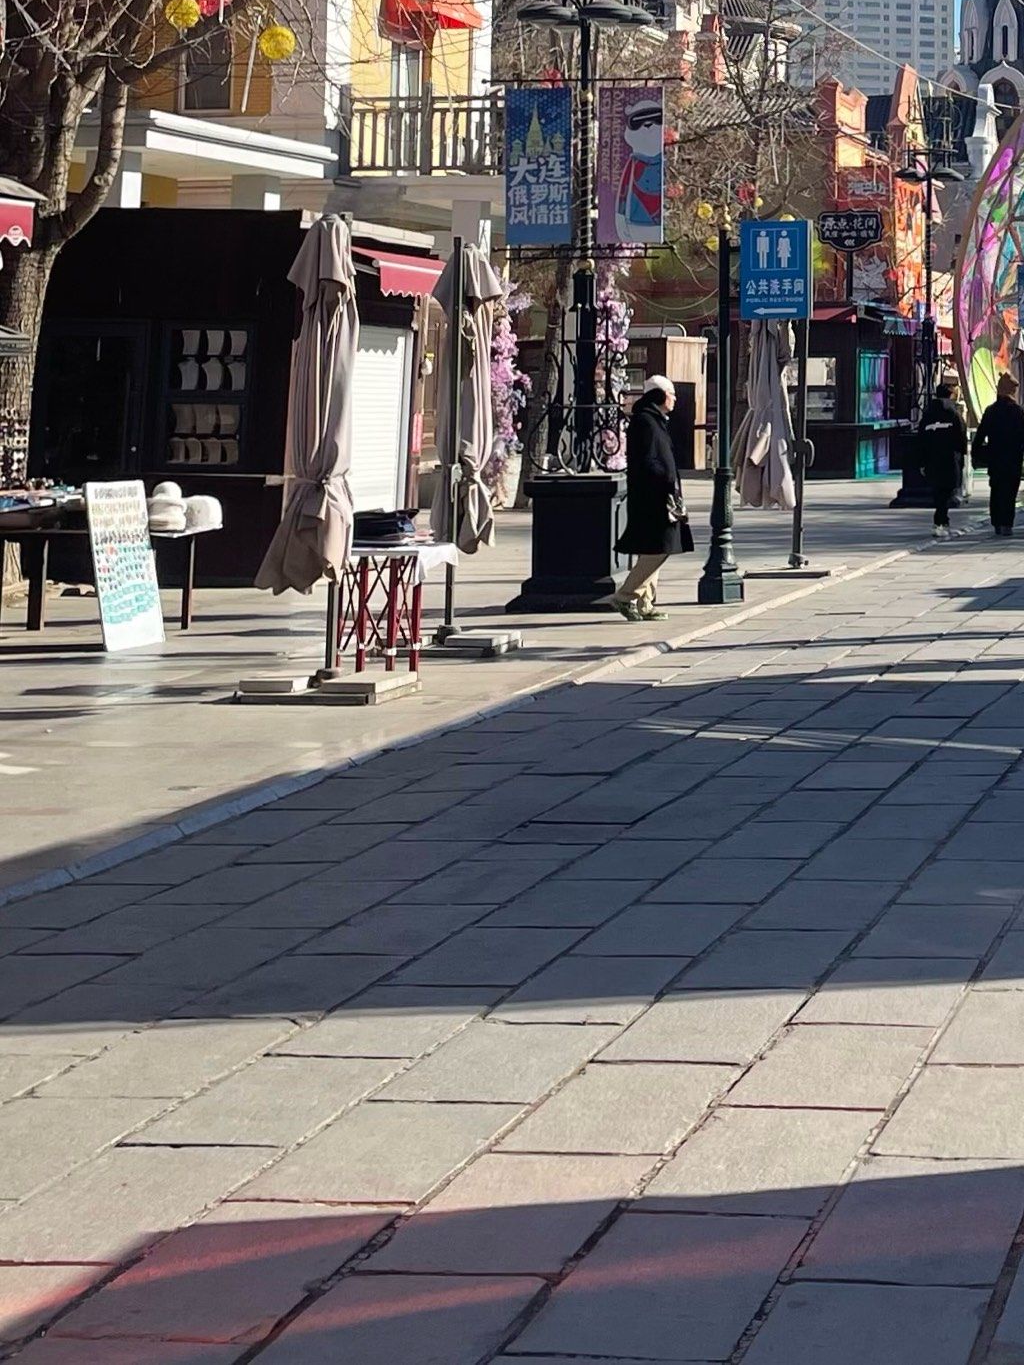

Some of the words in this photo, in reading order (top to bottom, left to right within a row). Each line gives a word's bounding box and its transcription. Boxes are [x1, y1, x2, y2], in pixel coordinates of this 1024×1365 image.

[509, 155, 569, 186] 大连
[508, 184, 569, 205] 俄罗斯
[509, 204, 569, 225] 风情街
[745, 278, 805, 295] 公共洗手间
